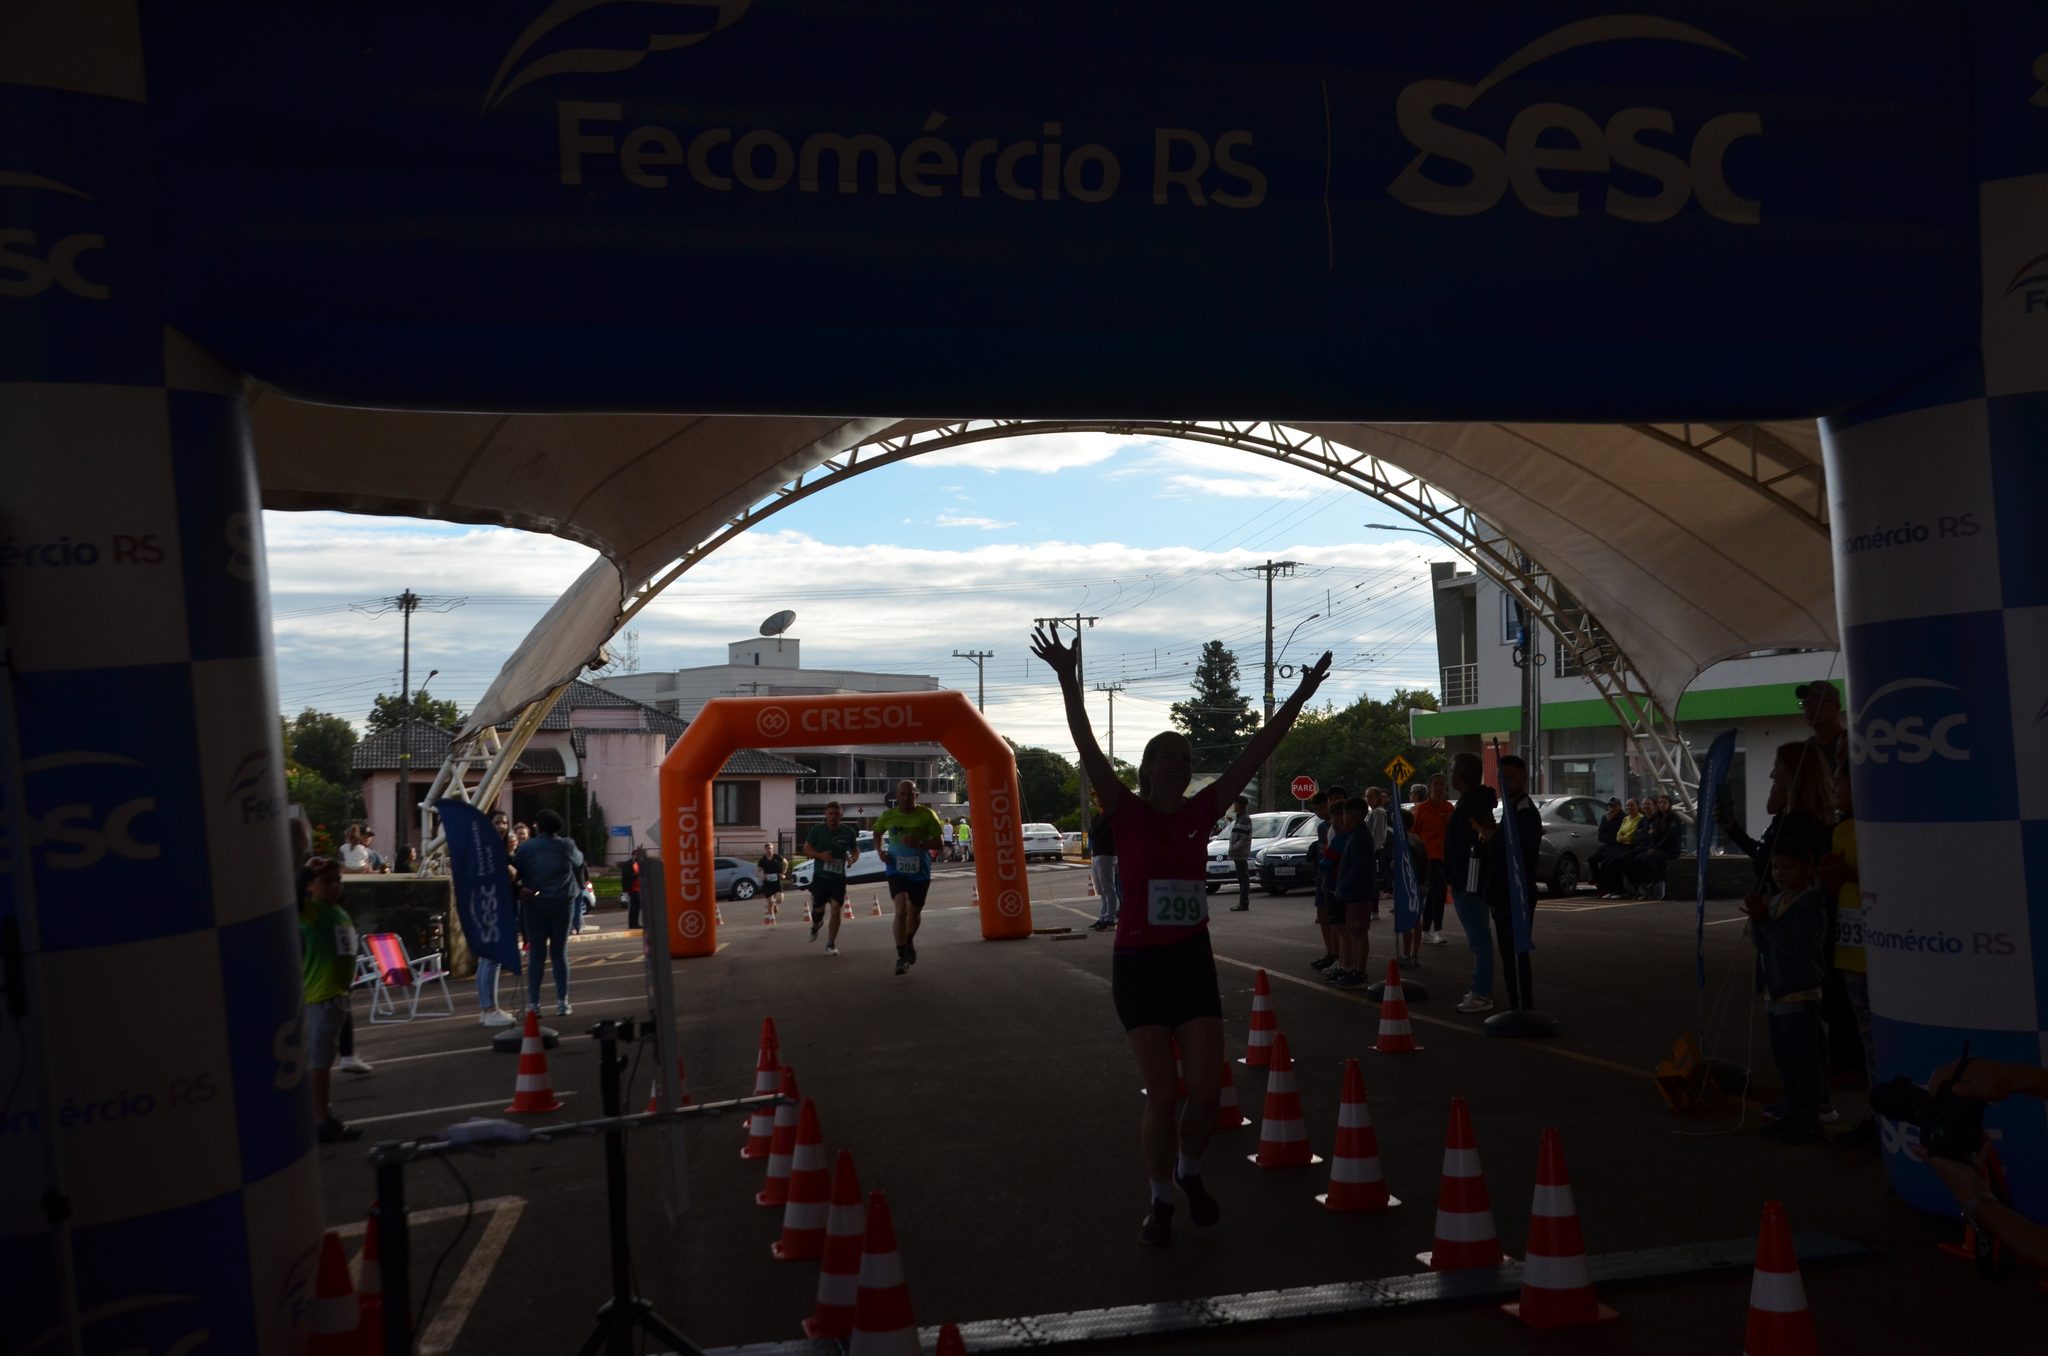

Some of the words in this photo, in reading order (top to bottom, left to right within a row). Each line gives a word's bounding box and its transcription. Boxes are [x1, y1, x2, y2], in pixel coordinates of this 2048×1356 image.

[557, 100, 1122, 203] Fecomércio
[1152, 127, 1267, 210] RS
[1386, 78, 1764, 225] Sesc
[1939, 512, 1981, 540] RS
[112, 534, 165, 566] RS
[801, 705, 923, 732] CRESOL
[1293, 784, 1313, 793] PARE
[991, 780, 1016, 881] CRESOL
[678, 798, 700, 901] CRESOL
[899, 862, 916, 872] 204
[1156, 896, 1201, 921] 299
[1973, 932, 2016, 955] RS
[168, 1072, 219, 1108] RS
